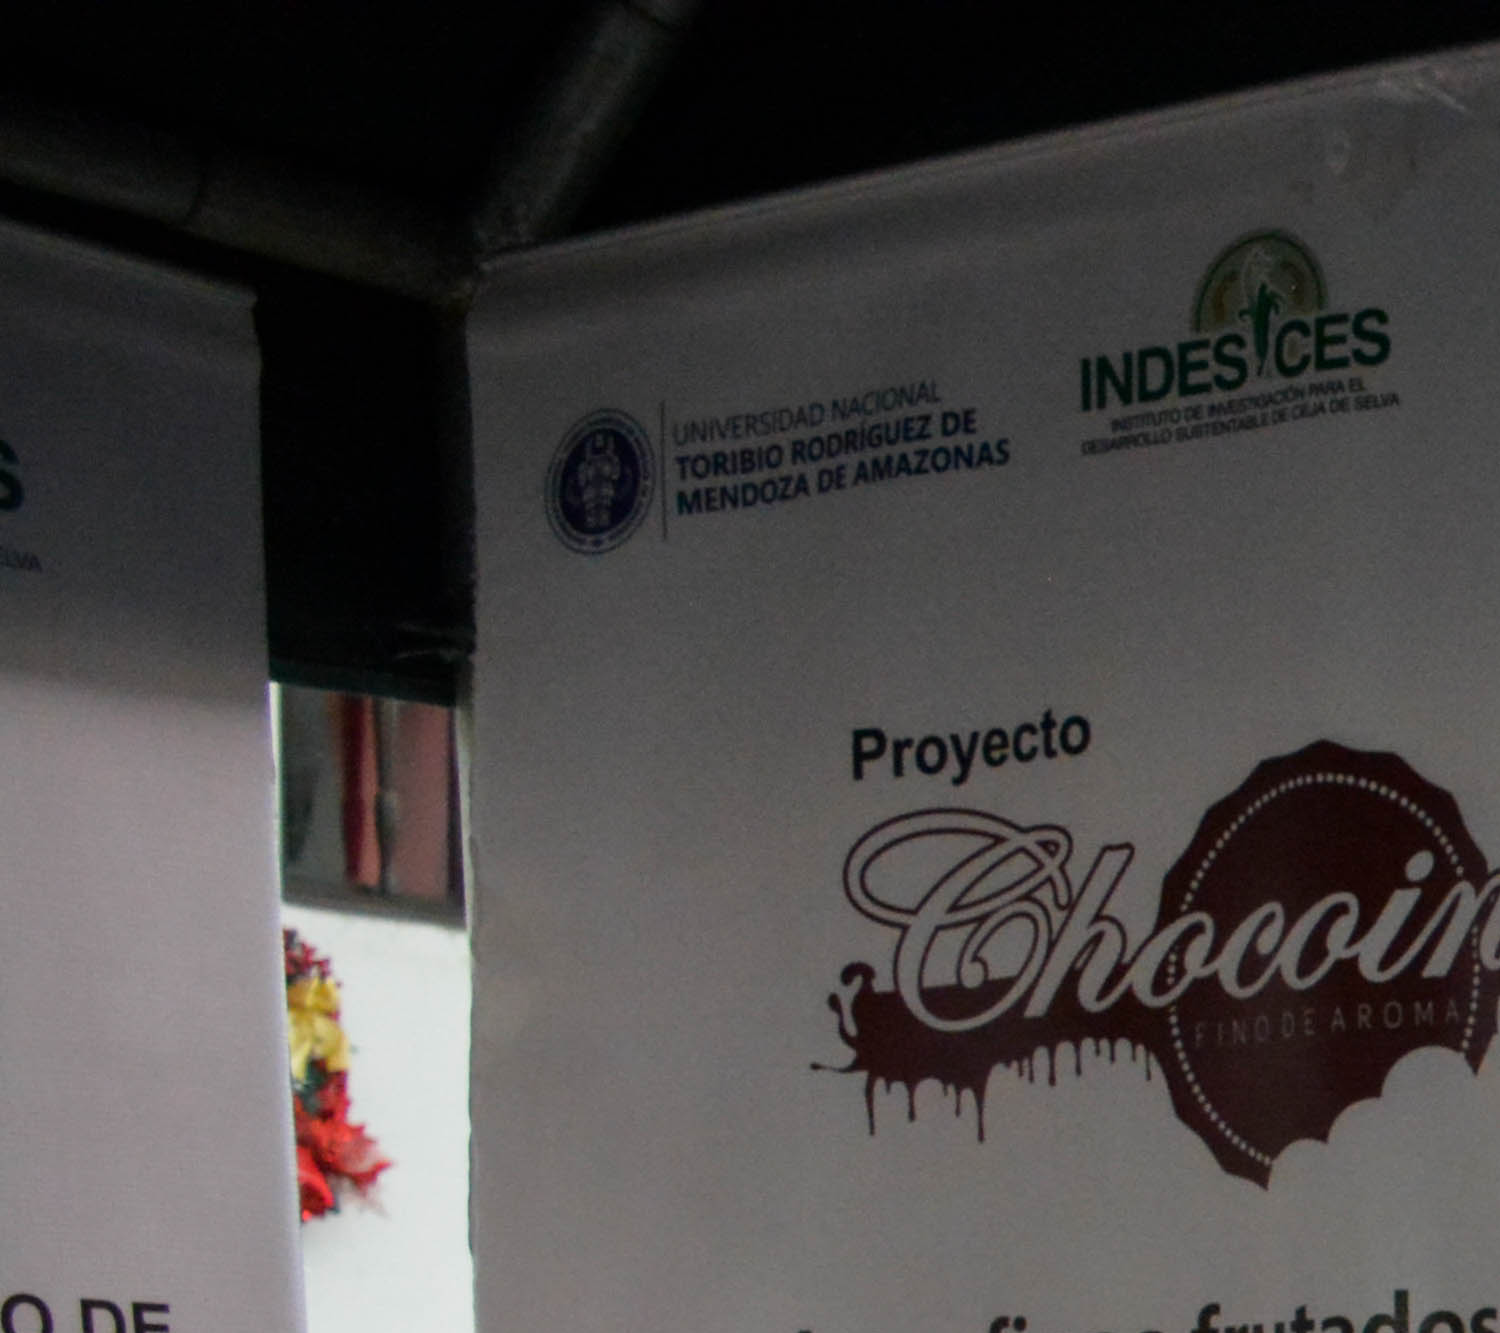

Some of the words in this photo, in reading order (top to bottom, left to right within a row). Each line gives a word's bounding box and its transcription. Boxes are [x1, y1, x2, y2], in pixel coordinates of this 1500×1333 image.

[672, 401, 825, 448] UNIVERSIDAD
[830, 378, 942, 421] NACIONAL
[1080, 429, 1174, 457] DESARROLLO
[1175, 414, 1270, 442] SUSTENTABLE
[1270, 406, 1289, 426] DE
[1328, 396, 1349, 414] DE
[1353, 392, 1401, 411] SELVA
[1111, 406, 1182, 432] INSTITUTO
[1184, 402, 1201, 423] DE
[1307, 378, 1346, 398] PARA
[1348, 377, 1366, 393] EL
[676, 445, 784, 482] TORIBIO
[791, 411, 932, 464] RODRÍGUEZ
[941, 407, 977, 438] DE
[677, 467, 810, 517] MENDOZA
[818, 463, 847, 495] DE
[852, 438, 1011, 487] AMAZONAS
[849, 711, 1094, 785] Proyecto
[1330, 998, 1461, 1037] AROMA
